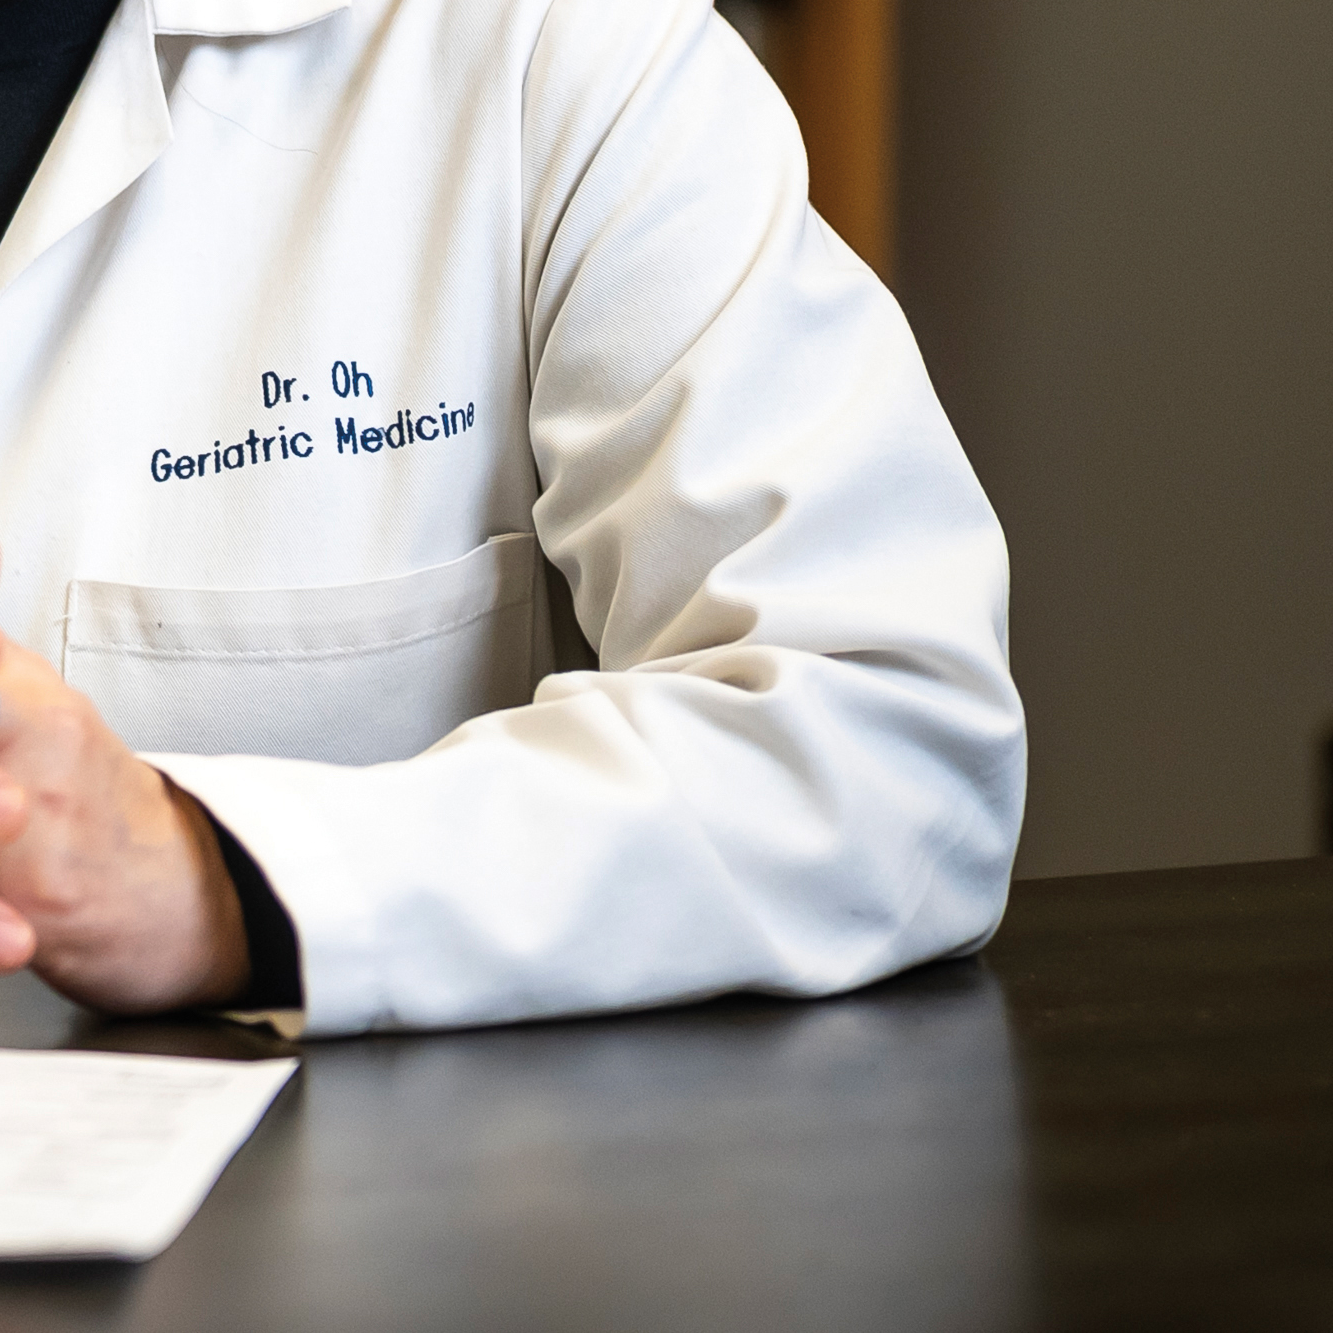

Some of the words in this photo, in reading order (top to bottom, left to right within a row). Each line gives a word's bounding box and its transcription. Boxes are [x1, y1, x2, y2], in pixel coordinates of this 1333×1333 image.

[261, 370, 310, 409] Dr.
[331, 360, 375, 398] Oh
[150, 425, 314, 483] Geriatric
[334, 402, 475, 455] Medicine
